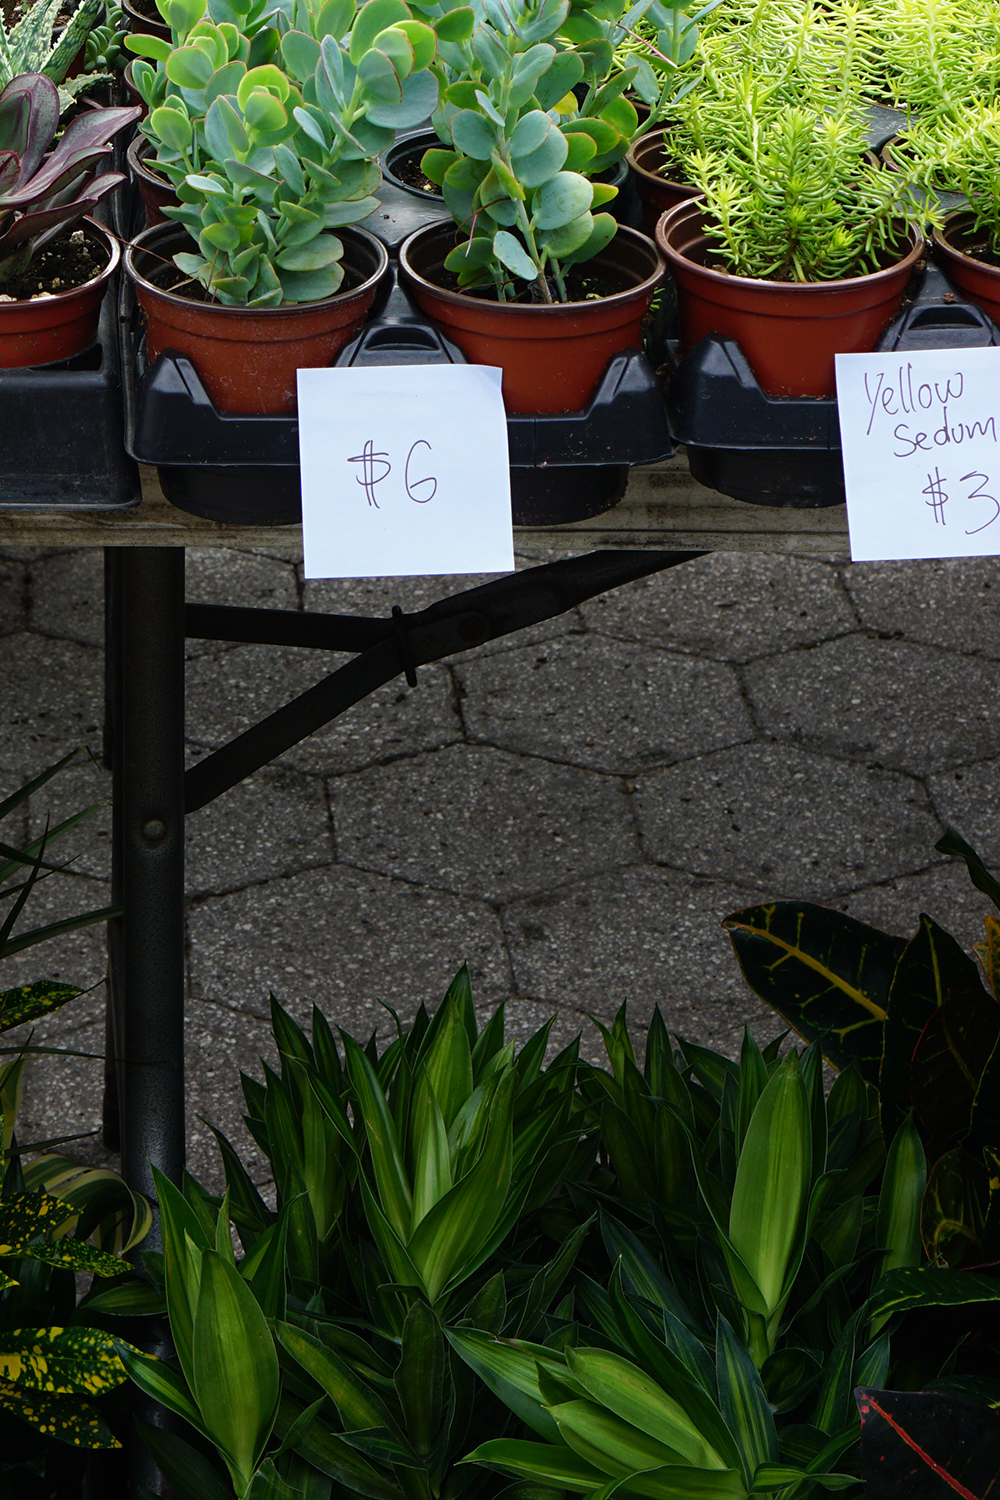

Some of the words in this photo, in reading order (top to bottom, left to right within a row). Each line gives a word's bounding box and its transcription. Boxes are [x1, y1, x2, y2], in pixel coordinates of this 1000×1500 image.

[864, 362, 964, 436] Yellow
[893, 406, 997, 457] Sedum
[346, 439, 438, 509] $6
[921, 466, 1000, 535] $3
